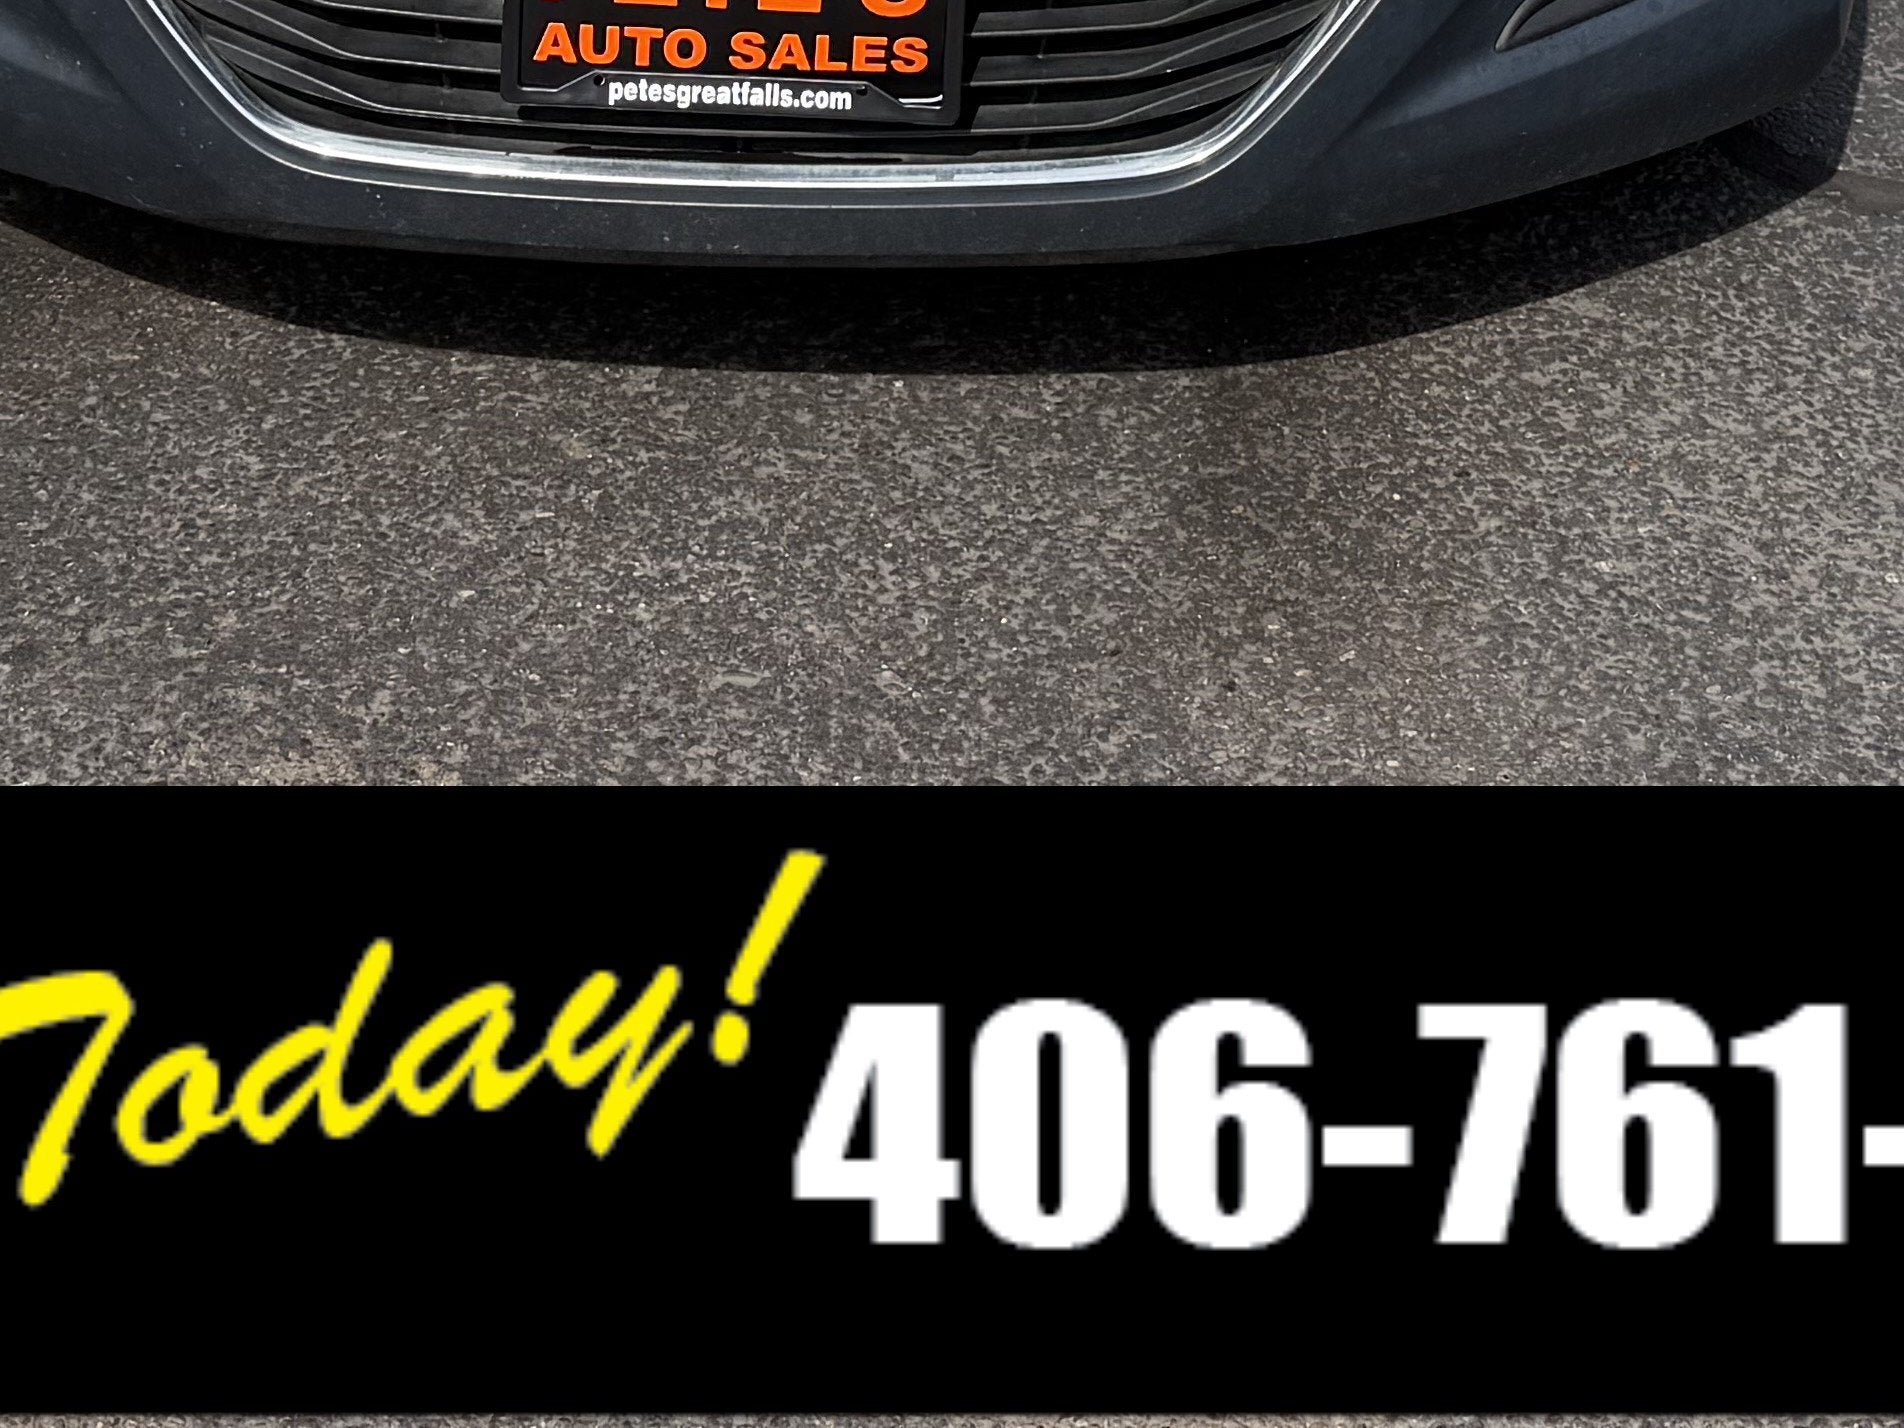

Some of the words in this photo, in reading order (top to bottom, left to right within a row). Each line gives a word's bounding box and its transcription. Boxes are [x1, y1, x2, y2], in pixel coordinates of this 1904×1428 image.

[532, 22, 707, 69] AUTO
[728, 31, 929, 74] SALES
[608, 78, 853, 111] petesgreatfalls.com
